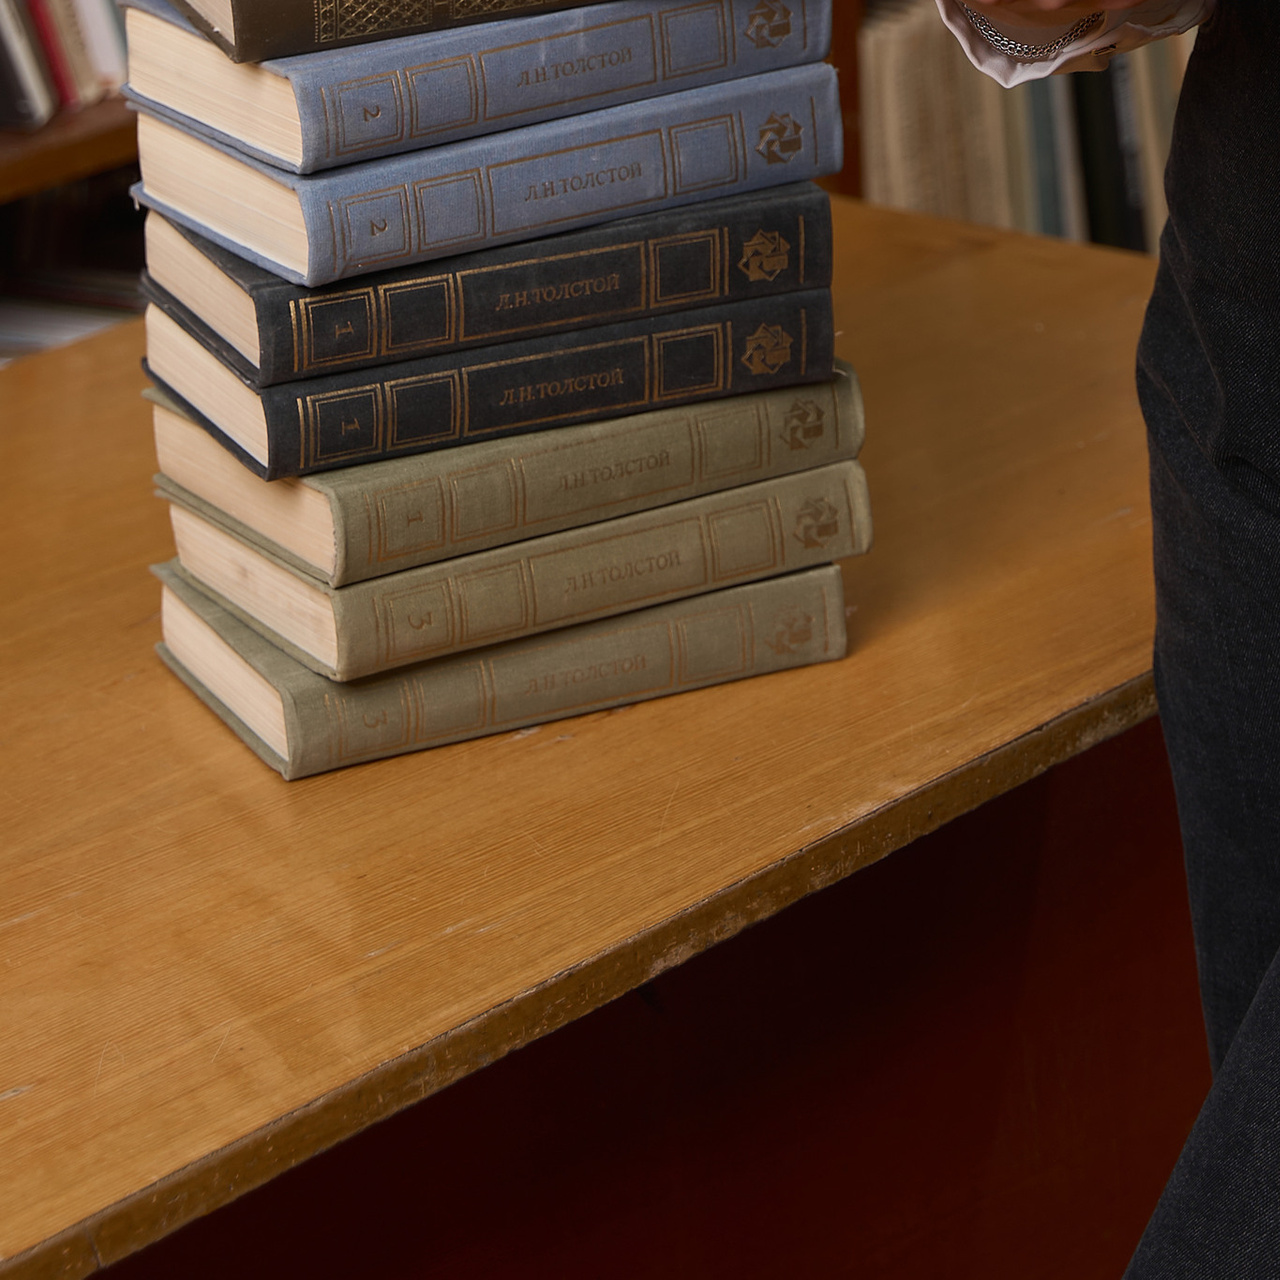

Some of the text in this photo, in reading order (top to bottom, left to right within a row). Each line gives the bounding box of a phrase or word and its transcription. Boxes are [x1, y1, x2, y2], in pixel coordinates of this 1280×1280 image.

[363, 105, 382, 123] 2
[370, 218, 389, 237] 2
[407, 611, 433, 631] 3
[362, 708, 389, 730] 3
